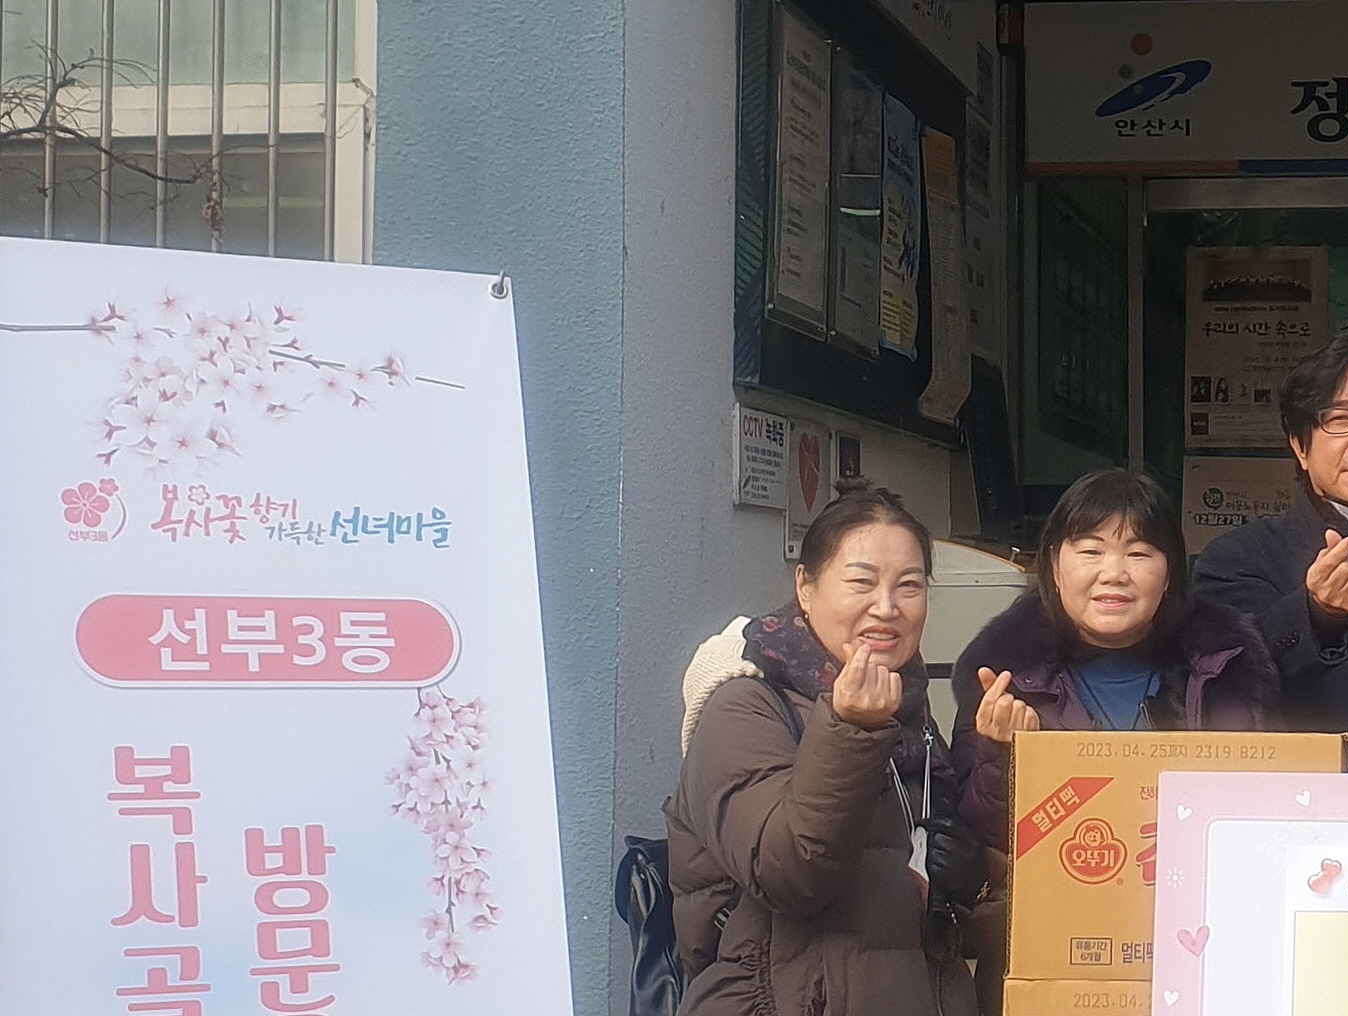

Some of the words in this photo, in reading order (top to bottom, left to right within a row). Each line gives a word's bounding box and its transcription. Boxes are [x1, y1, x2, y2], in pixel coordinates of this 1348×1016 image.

[1113, 117, 1193, 138] 안산시
[1201, 321, 1240, 338] 우리의
[1243, 321, 1272, 336] 시간
[1274, 318, 1312, 339] 속으로
[150, 484, 248, 544] 복사꽃
[249, 491, 299, 525] 향기
[264, 521, 326, 547] 가득한
[329, 506, 452, 549] 선녀마을
[147, 606, 396, 675] 선부3동
[1195, 743, 1232, 760] 2319
[1071, 848, 1116, 868] 오뚜기
[1073, 993, 1150, 1009] 2023.04.
